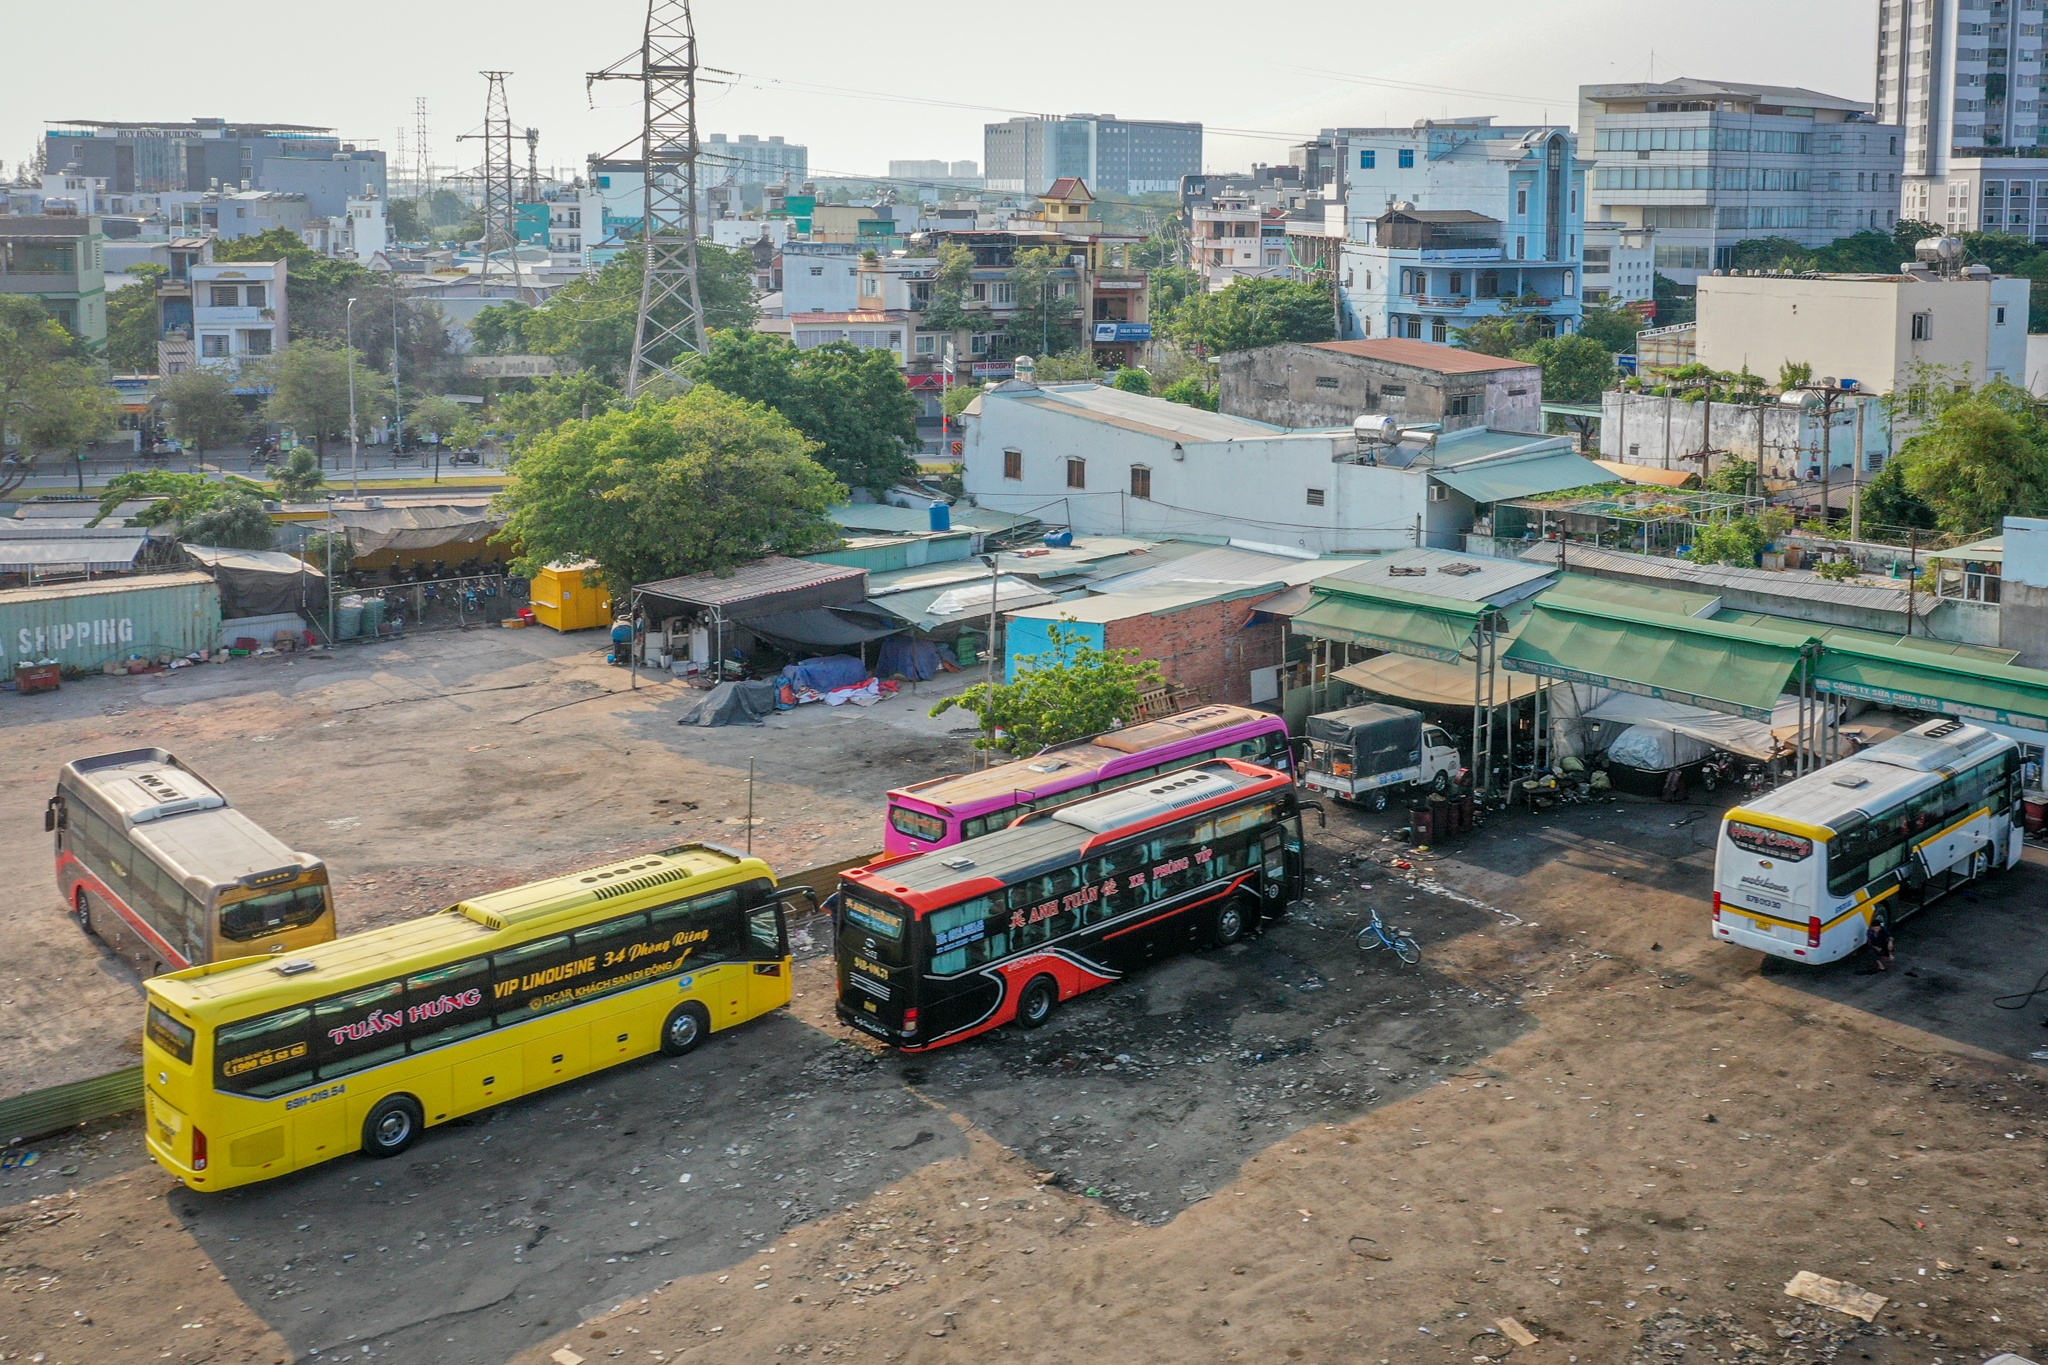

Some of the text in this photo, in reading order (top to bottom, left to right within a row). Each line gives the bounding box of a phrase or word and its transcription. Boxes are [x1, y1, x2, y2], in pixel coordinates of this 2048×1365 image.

[117, 130, 134, 138] HUY
[163, 130, 202, 139] BUILDING
[19, 618, 133, 653] SHIPPING
[1833, 681, 1857, 692] CÔNG
[1859, 686, 1870, 694] TY
[1128, 872, 1146, 889] XE
[1028, 882, 1099, 924] ANH TUẤN
[493, 978, 520, 999] VIP
[522, 956, 597, 991] LIMOUSINE
[602, 947, 627, 968] 34
[574, 980, 612, 997] KHÁCH
[633, 969, 644, 980] DI
[328, 988, 482, 1045] TUẤN HƯNG
[231, 1059, 258, 1074] 1900
